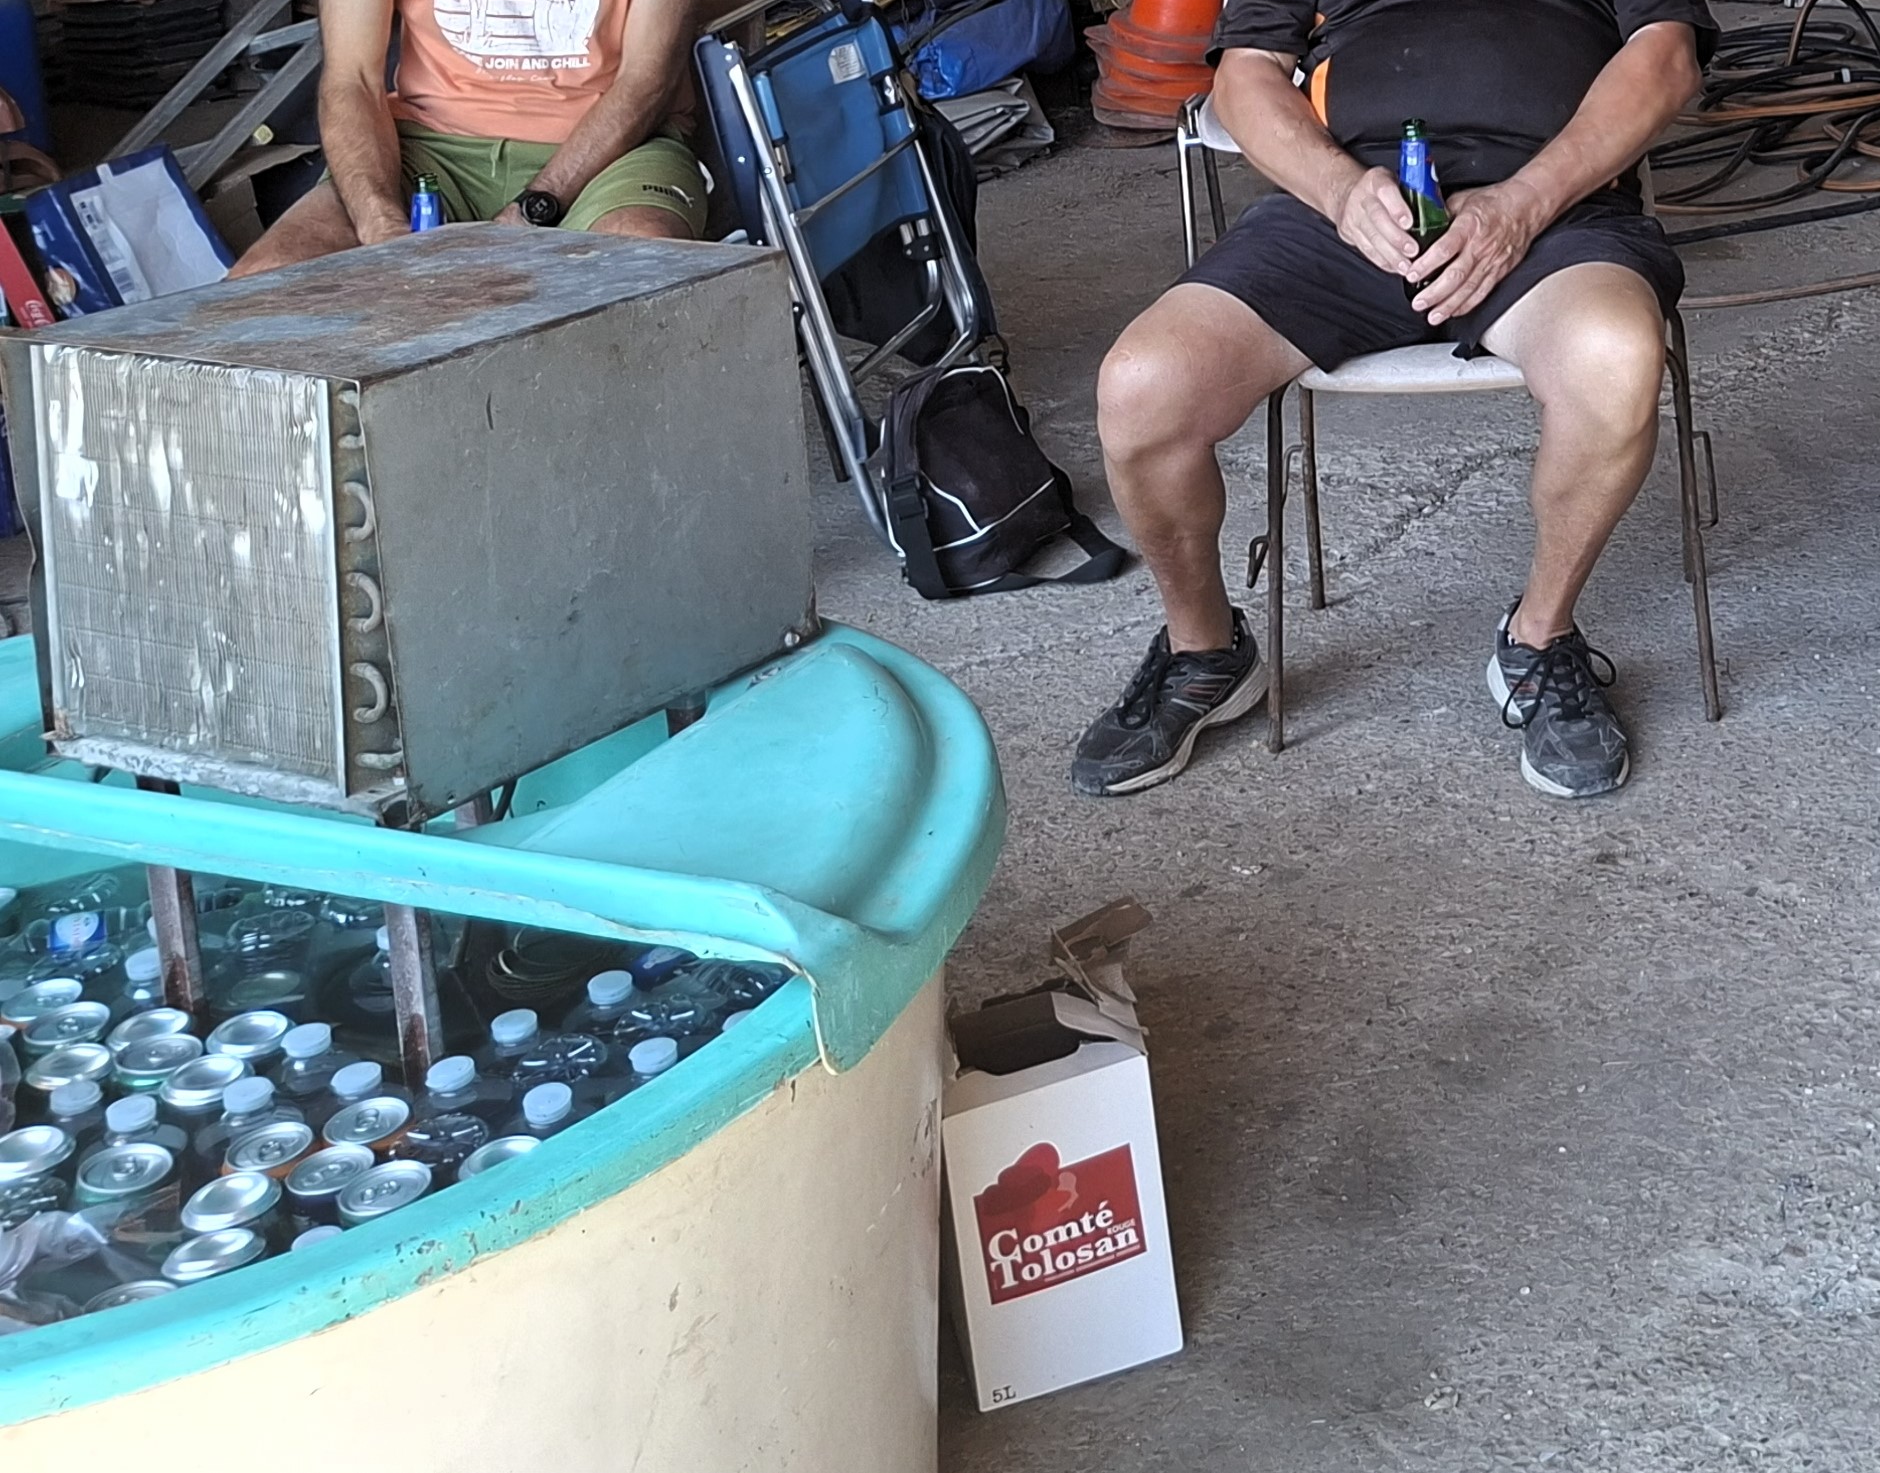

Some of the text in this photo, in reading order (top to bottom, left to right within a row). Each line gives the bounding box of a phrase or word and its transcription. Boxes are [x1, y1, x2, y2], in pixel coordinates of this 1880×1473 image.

[485, 57, 519, 70] JOIN
[521, 58, 549, 70] AND
[551, 57, 592, 70] CHILL
[988, 1200, 1114, 1264] Comté
[990, 1228, 1139, 1289] Tolosan
[992, 1385, 1016, 1403] 5L
